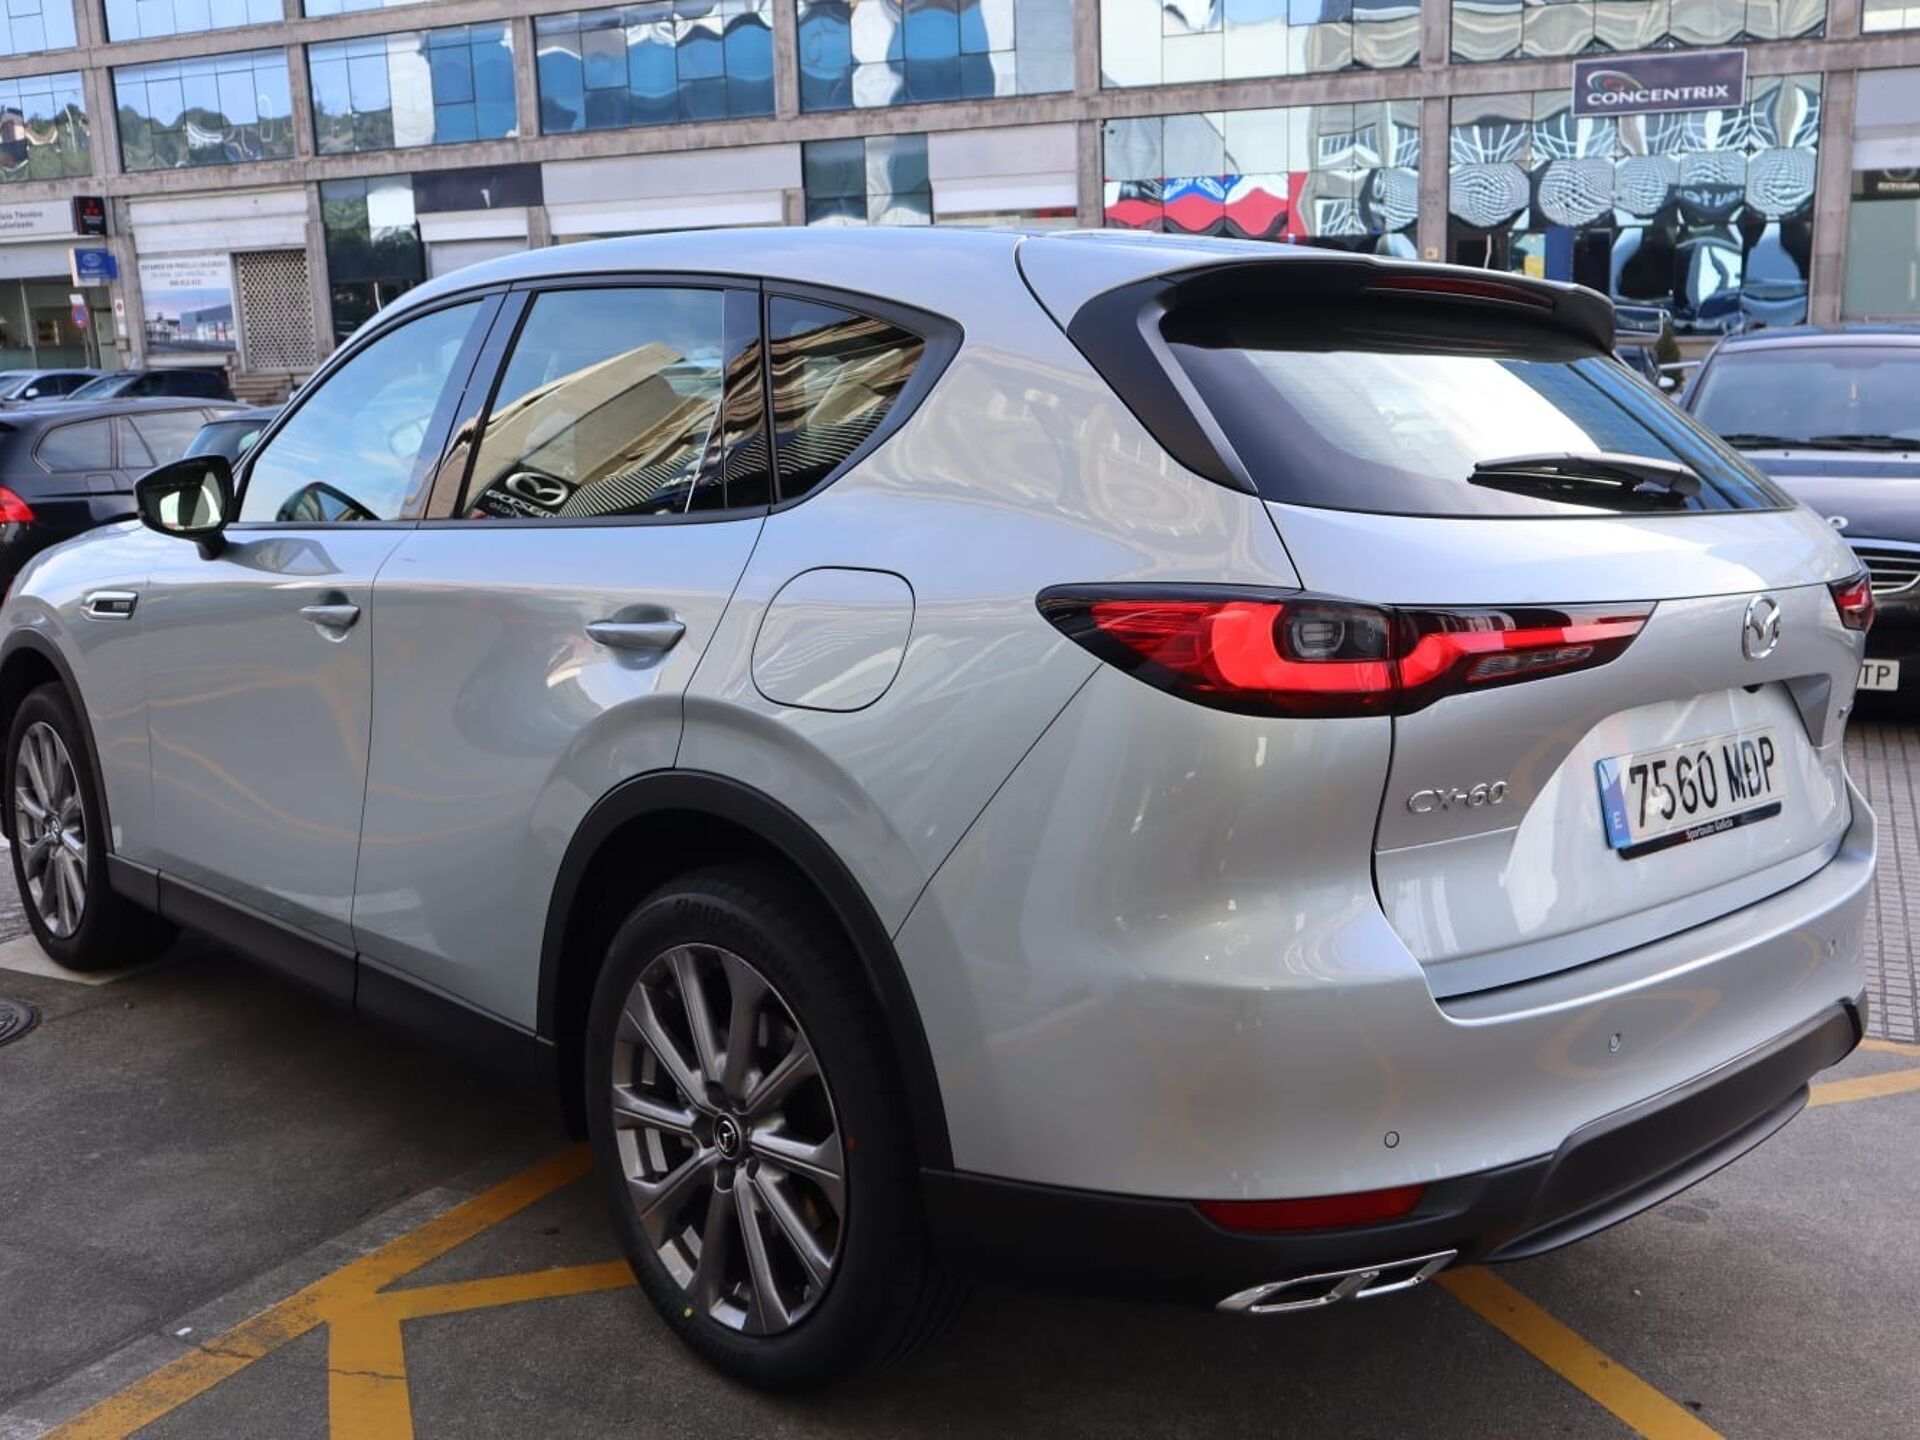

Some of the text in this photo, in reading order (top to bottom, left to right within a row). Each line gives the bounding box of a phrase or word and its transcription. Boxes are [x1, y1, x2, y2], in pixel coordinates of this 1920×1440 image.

[1586, 84, 1729, 106] CONCENTRIX
[1629, 736, 1775, 828] 7560 MDP
[1408, 780, 1508, 813] CX-60
[1612, 811, 1623, 829] E
